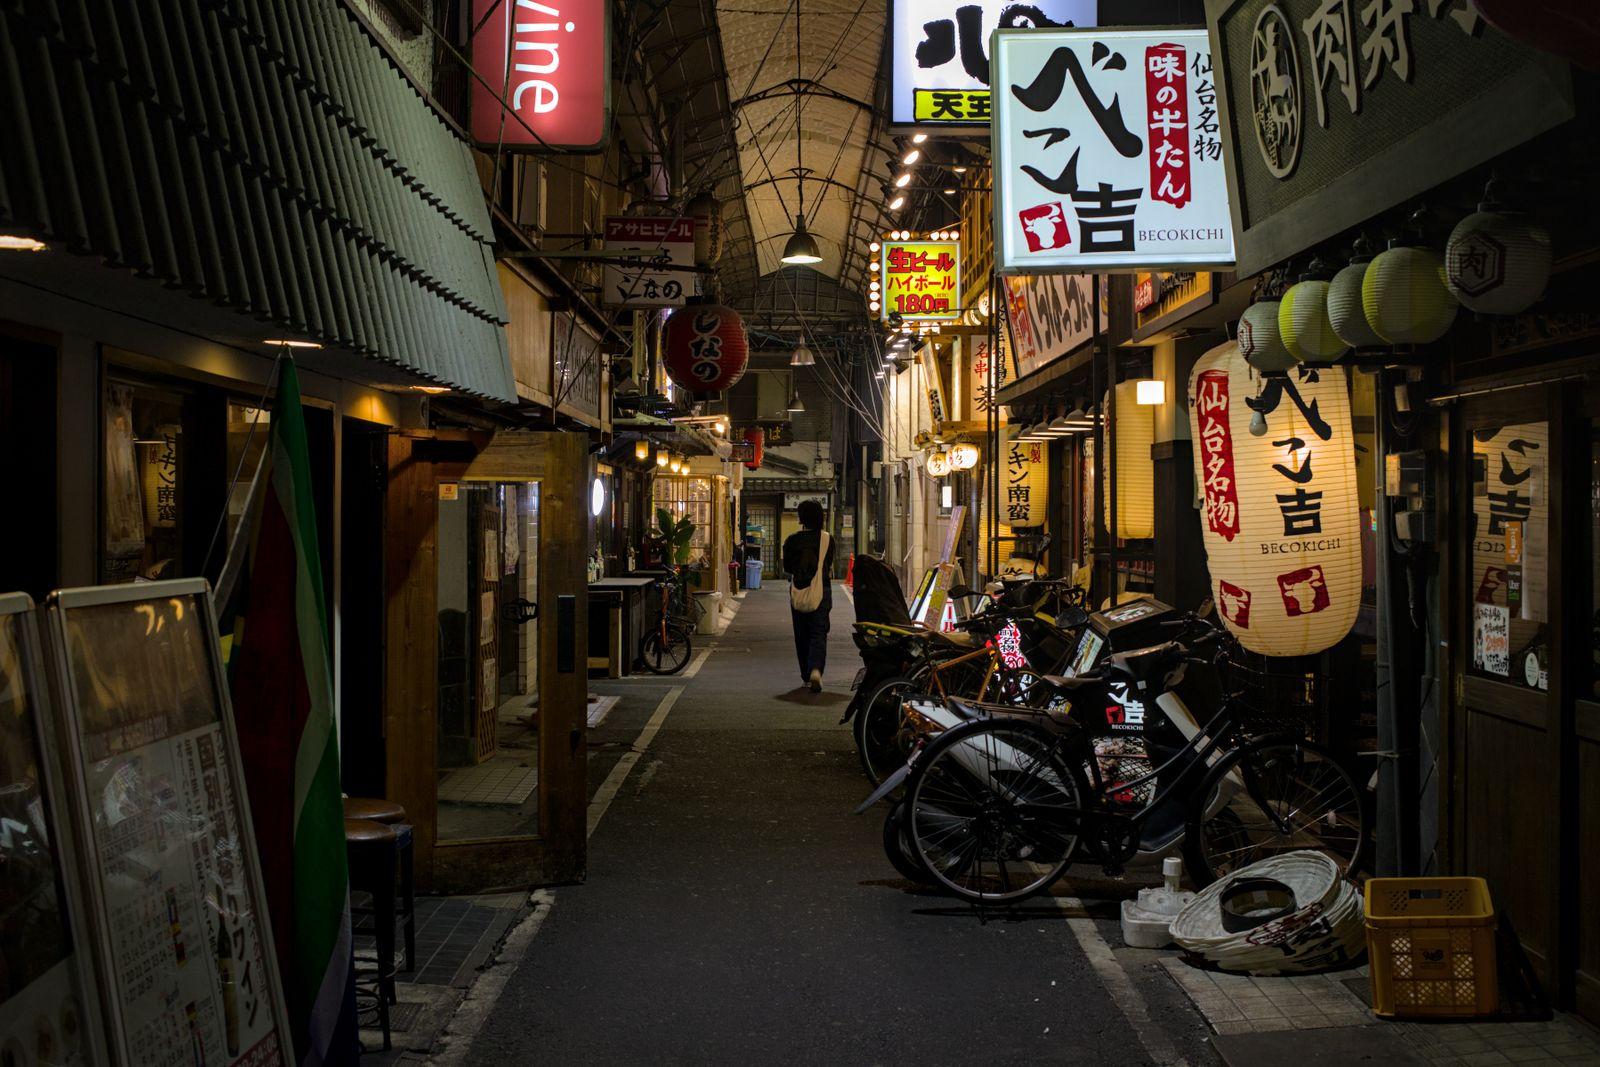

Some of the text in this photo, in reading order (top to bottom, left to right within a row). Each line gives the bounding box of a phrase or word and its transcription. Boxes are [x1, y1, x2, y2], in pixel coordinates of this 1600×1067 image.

[1191, 52, 1222, 162] 仙台名物
[1149, 53, 1187, 199] 味の牛たん
[1011, 41, 1144, 254] べこ吉
[609, 221, 692, 237] アサヒビール
[1138, 228, 1224, 242] BECOKICHI
[887, 247, 956, 273] 生ビール
[1458, 246, 1488, 279] 肉
[888, 275, 956, 292] ハイボール
[895, 293, 950, 315] 180円
[1198, 380, 1237, 530] 仙台名物
[1260, 538, 1341, 555] BECOKICHI
